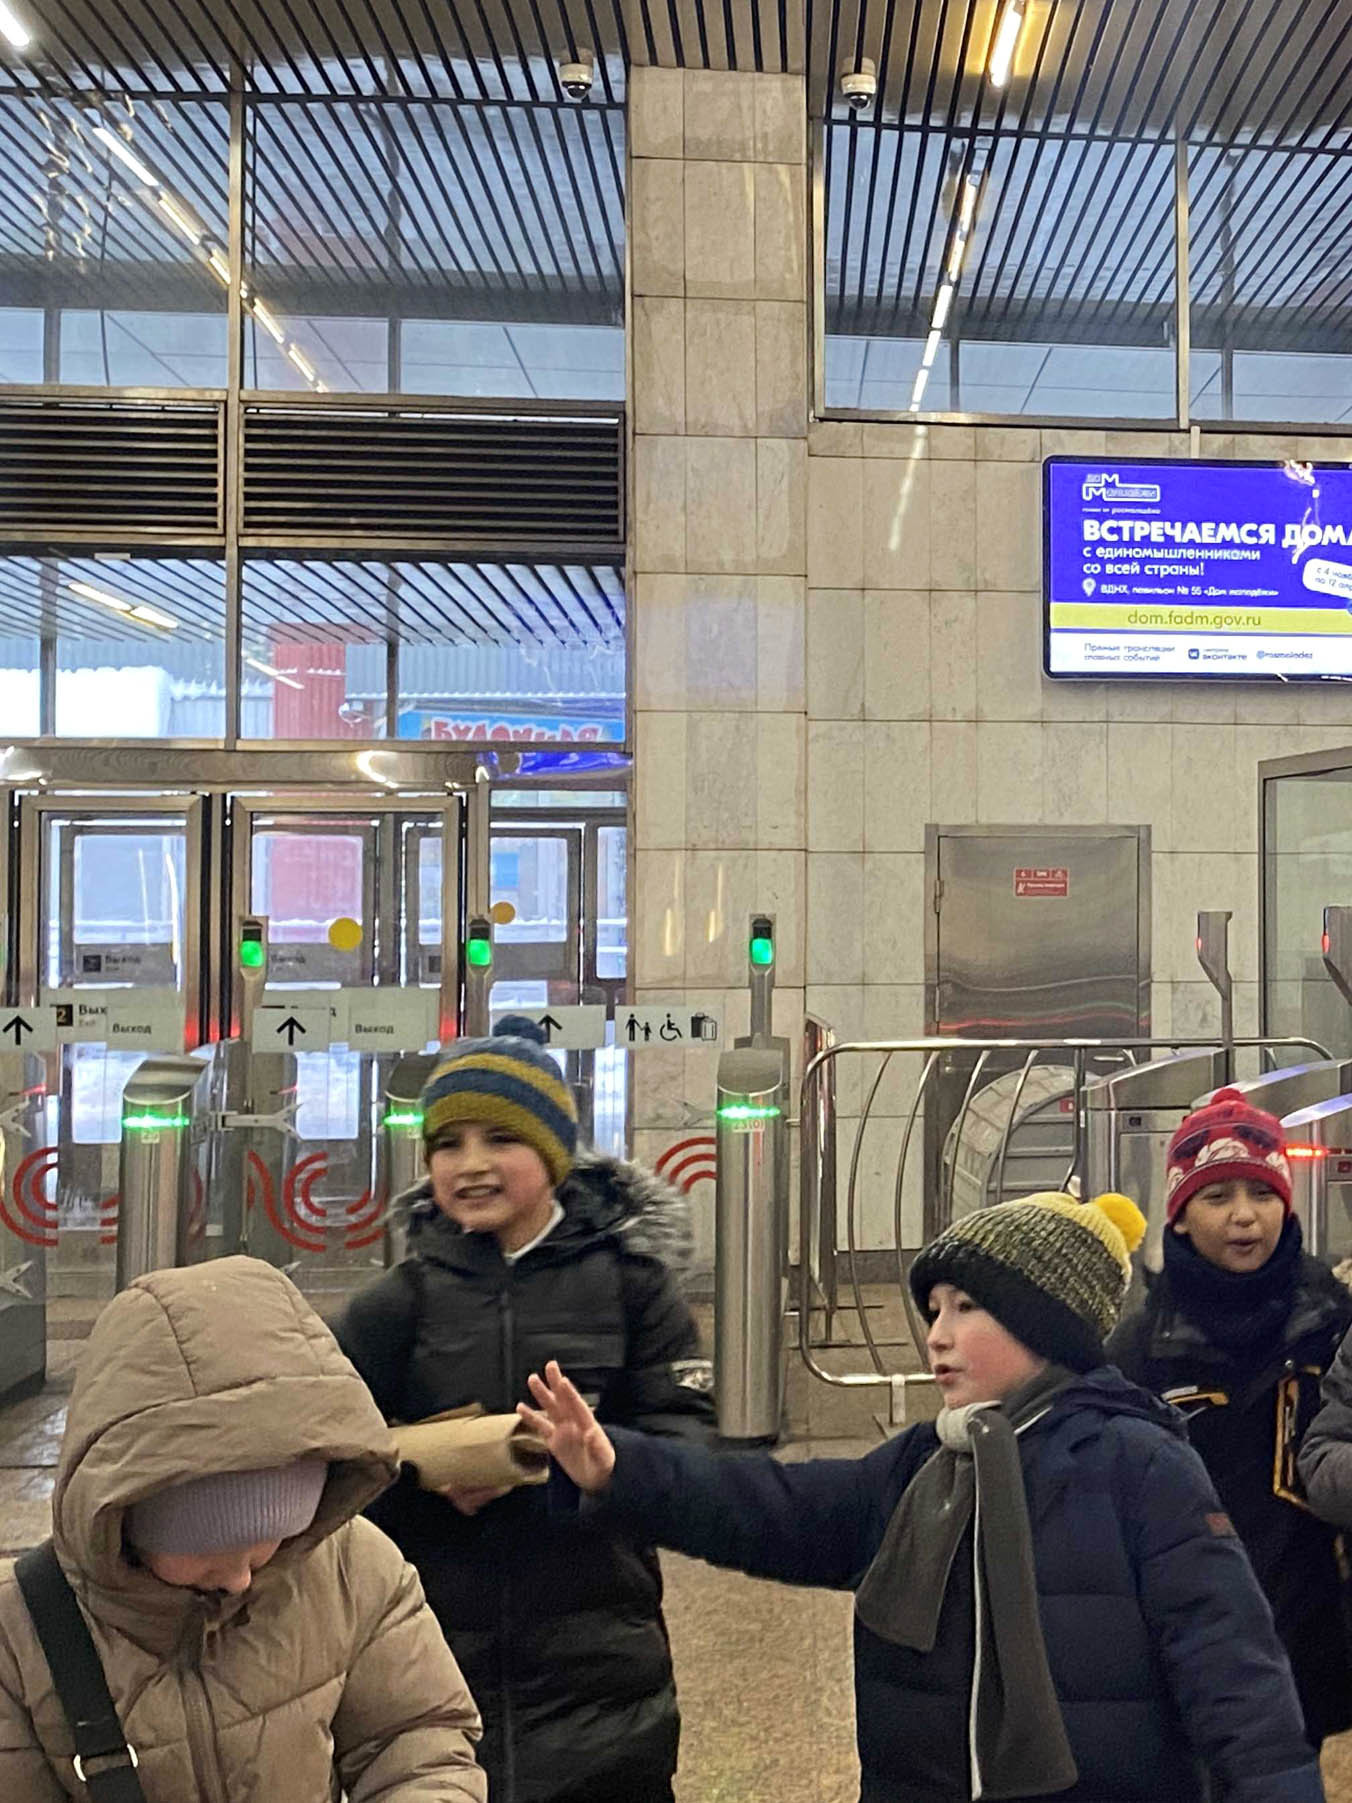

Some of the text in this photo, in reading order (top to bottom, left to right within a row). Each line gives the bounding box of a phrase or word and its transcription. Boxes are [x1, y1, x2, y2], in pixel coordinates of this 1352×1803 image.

[1083, 519, 1276, 545] ВСТРЕЧАЕМСЯ
[1083, 546, 1261, 561] с единомышленниками
[1083, 561, 1205, 578] со всей страны!
[1127, 610, 1261, 629] dom.fadm.gov.ru
[79, 1004, 108, 1016] Вых
[113, 1023, 152, 1035] Выход
[355, 1023, 394, 1035] Выход
